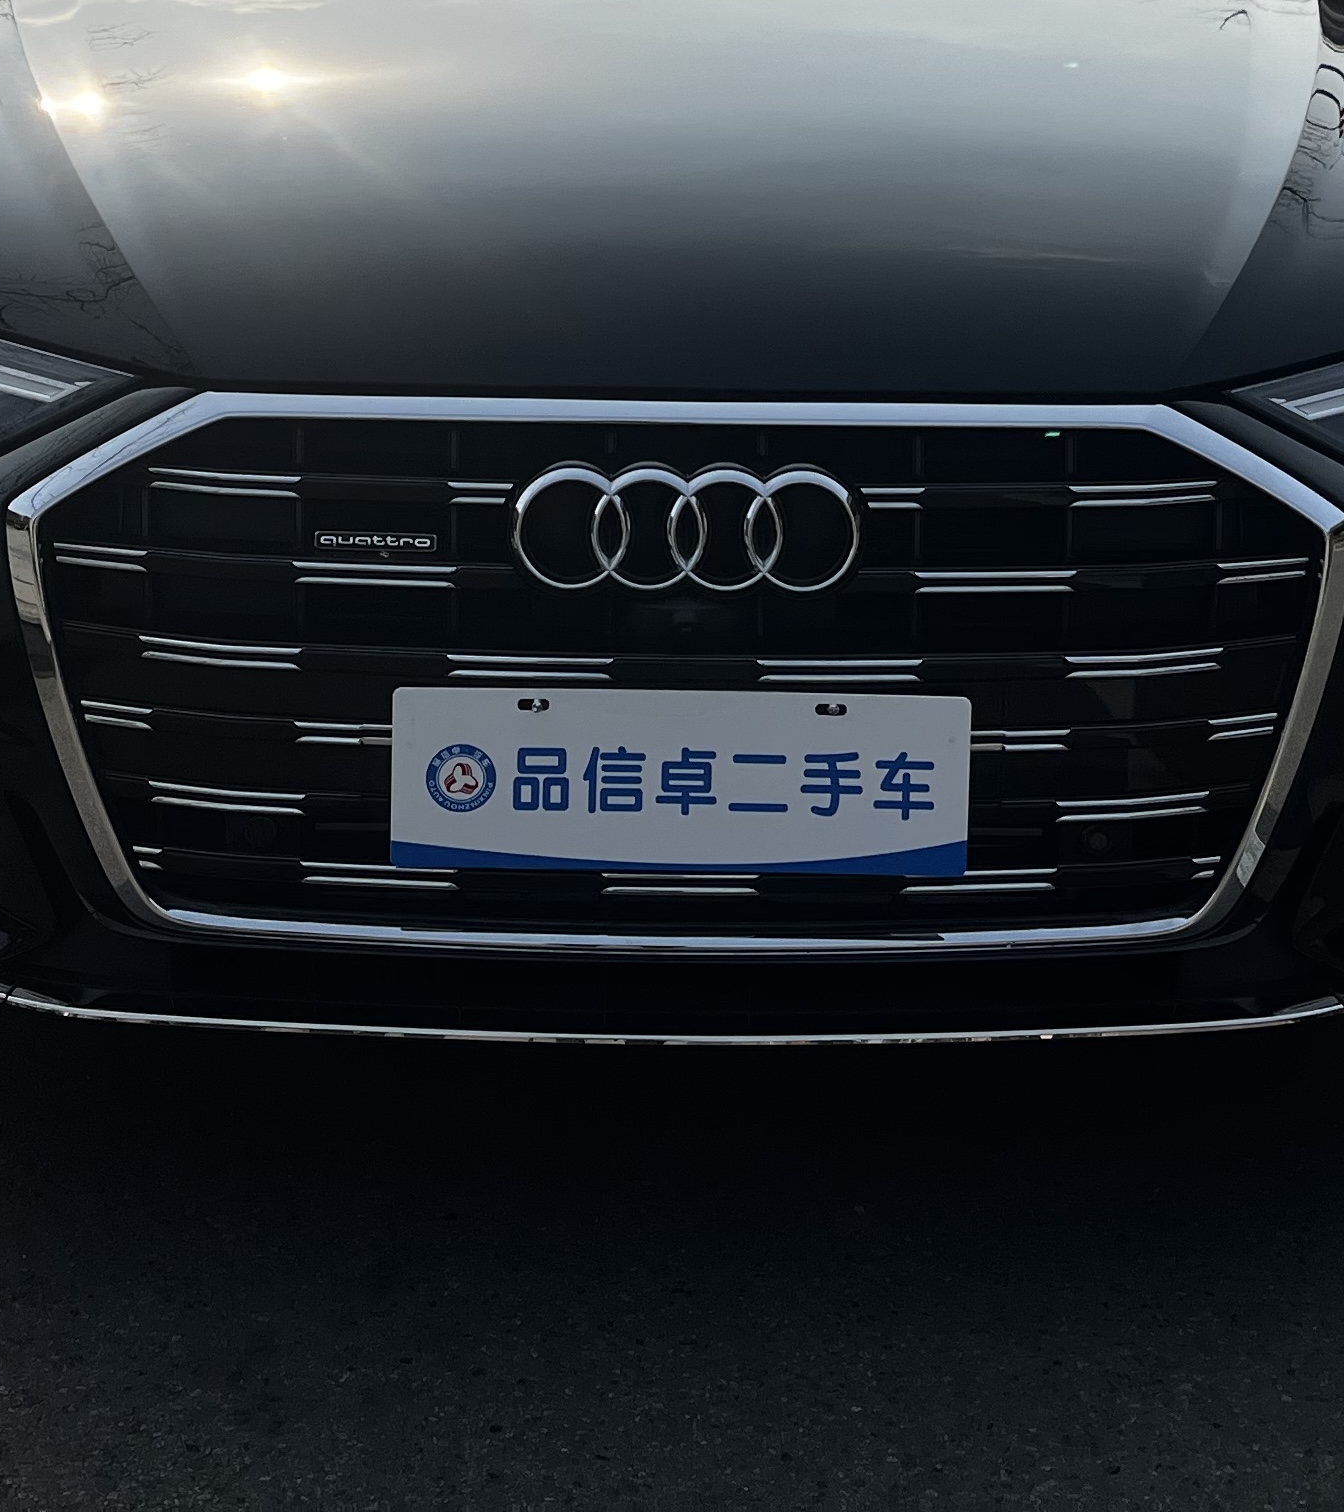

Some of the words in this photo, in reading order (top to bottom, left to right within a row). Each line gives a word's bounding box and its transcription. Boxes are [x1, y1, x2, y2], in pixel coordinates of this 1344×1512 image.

[320, 535, 431, 548] quattro
[512, 746, 935, 821] 品信卓二手车
